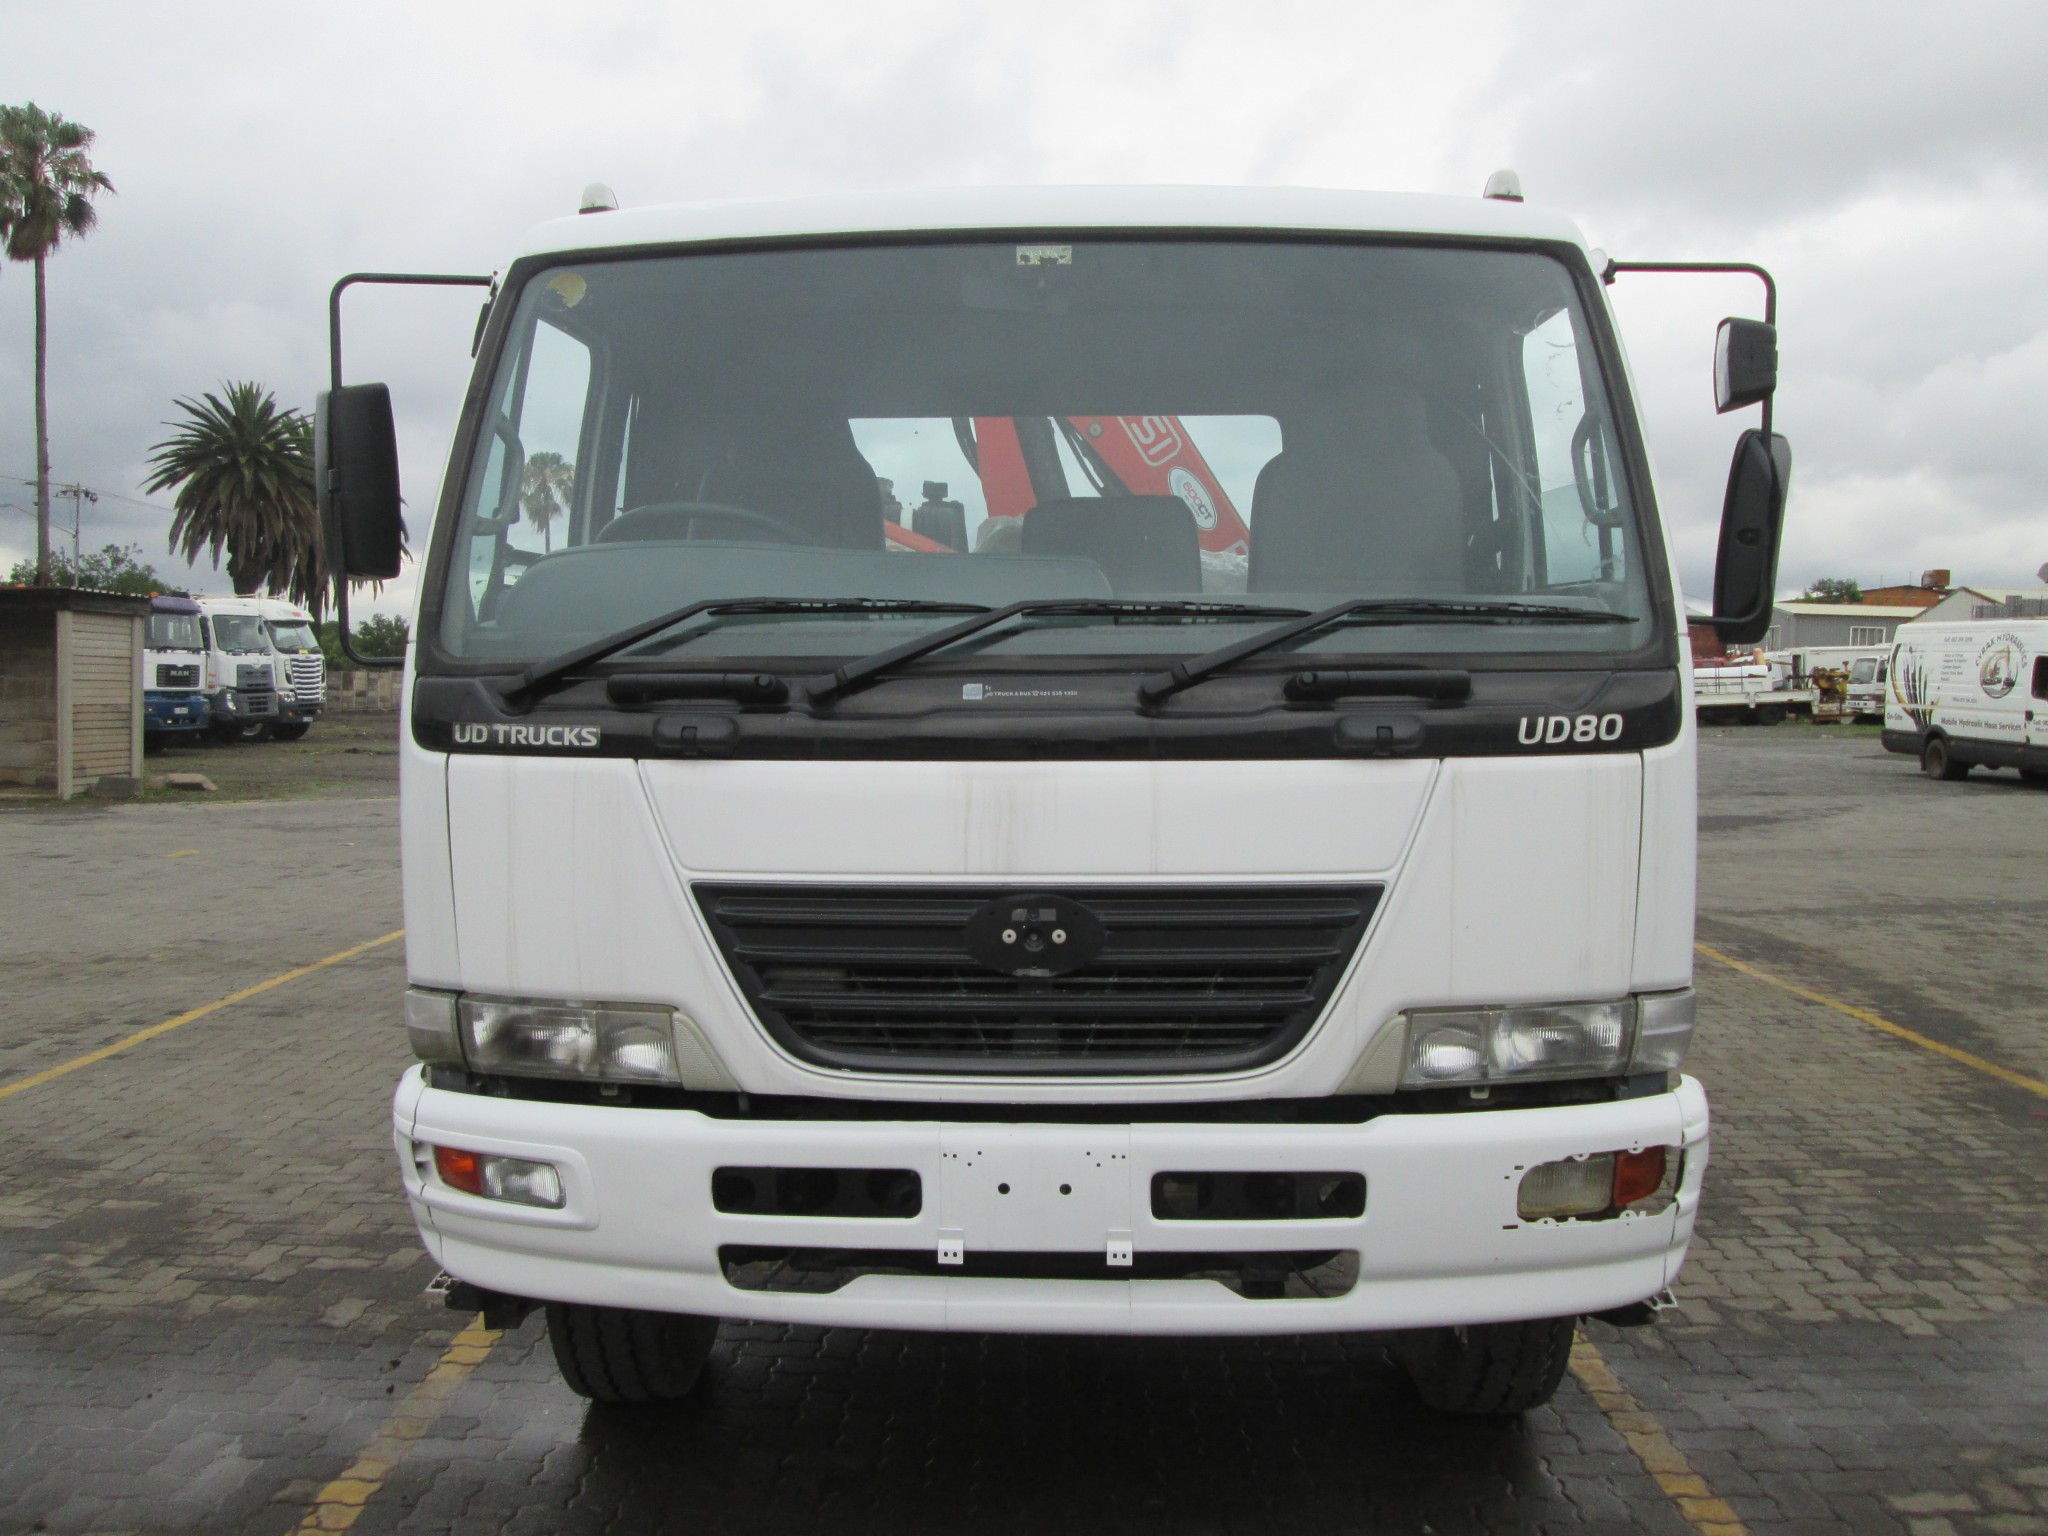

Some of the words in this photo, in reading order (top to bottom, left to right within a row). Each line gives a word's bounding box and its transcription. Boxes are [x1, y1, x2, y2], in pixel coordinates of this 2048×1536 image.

[1996, 633, 2028, 669] HYDRAULICS
[454, 724, 488, 744] UD
[492, 724, 599, 747] TRUCKS
[1518, 713, 1623, 745] UD80
[1940, 717, 1957, 726] Mobile
[1983, 720, 1998, 729] Hose
[1998, 722, 2021, 731] Services
